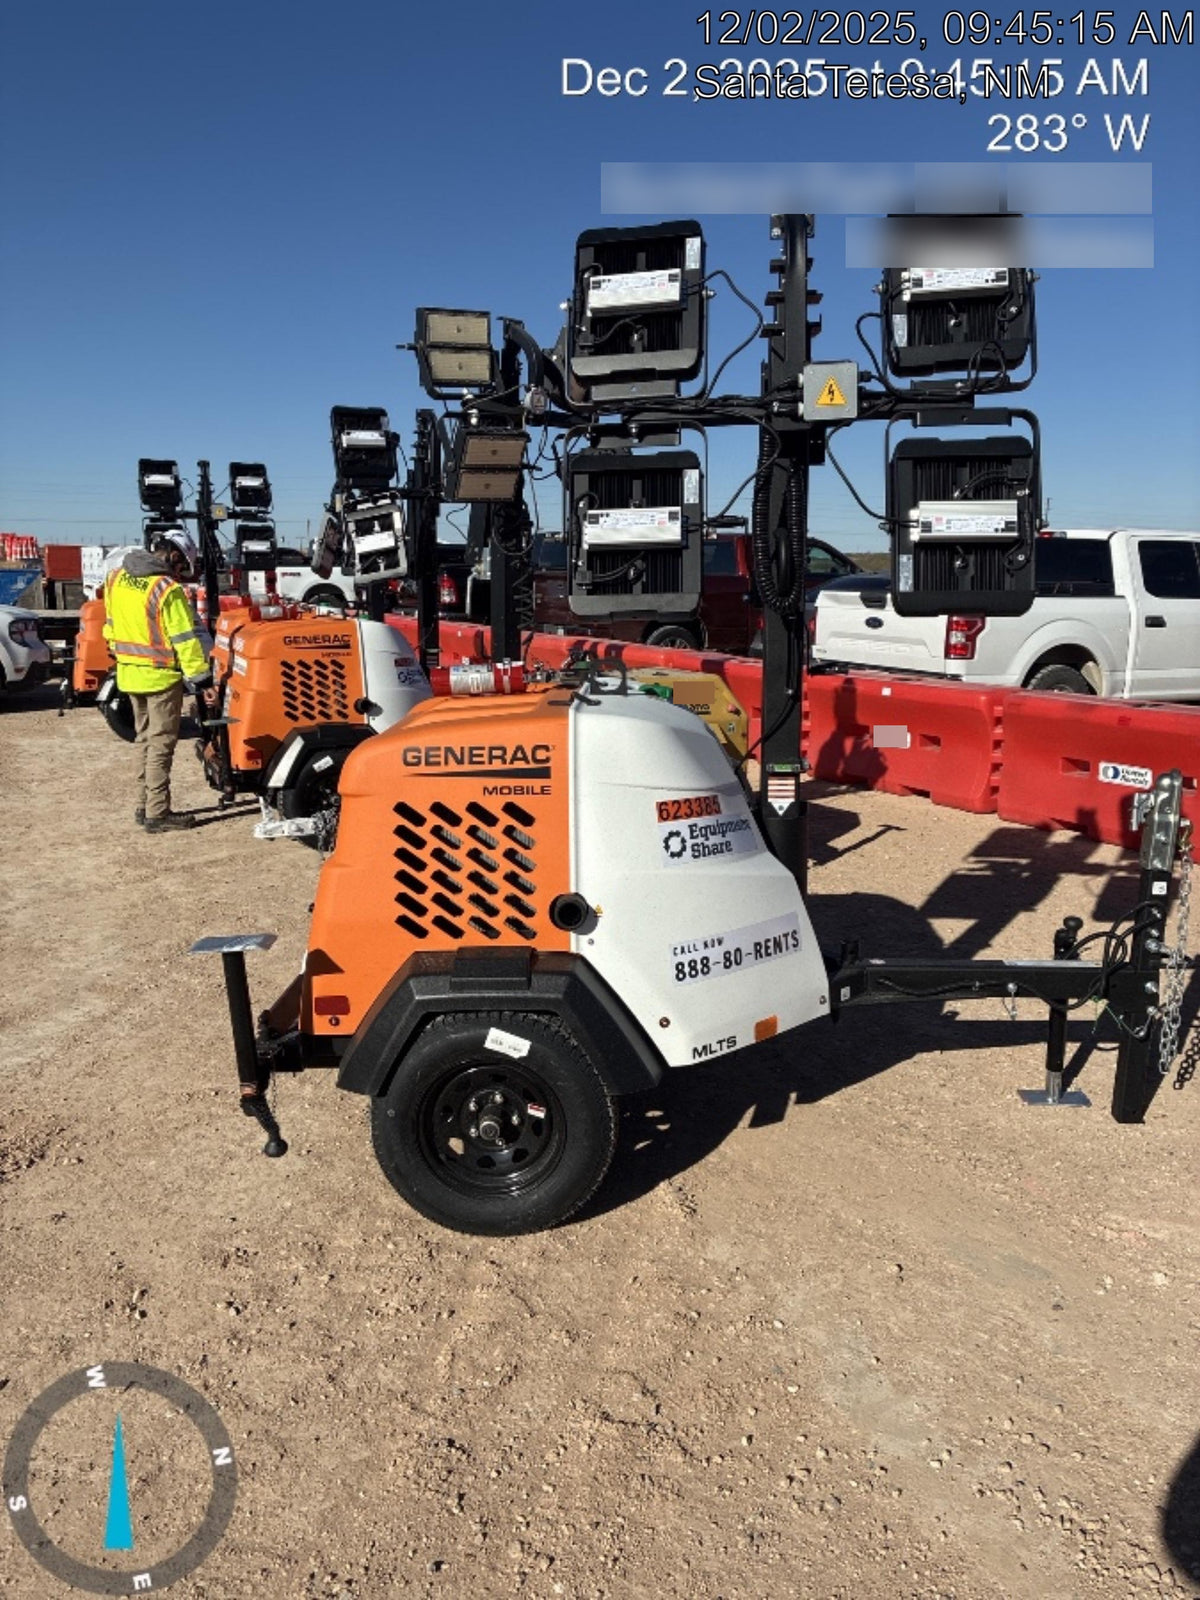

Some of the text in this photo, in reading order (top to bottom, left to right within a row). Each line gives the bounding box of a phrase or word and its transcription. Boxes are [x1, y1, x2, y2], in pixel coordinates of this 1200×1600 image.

[284, 634, 352, 647] GENERAC
[402, 744, 552, 767] GENERAC
[483, 785, 552, 797] MOBILE
[690, 840, 734, 859] Share
[673, 943, 699, 957] CALL
[675, 929, 800, 982] 888-80-RENTS
[692, 1035, 737, 1060] MLTS
